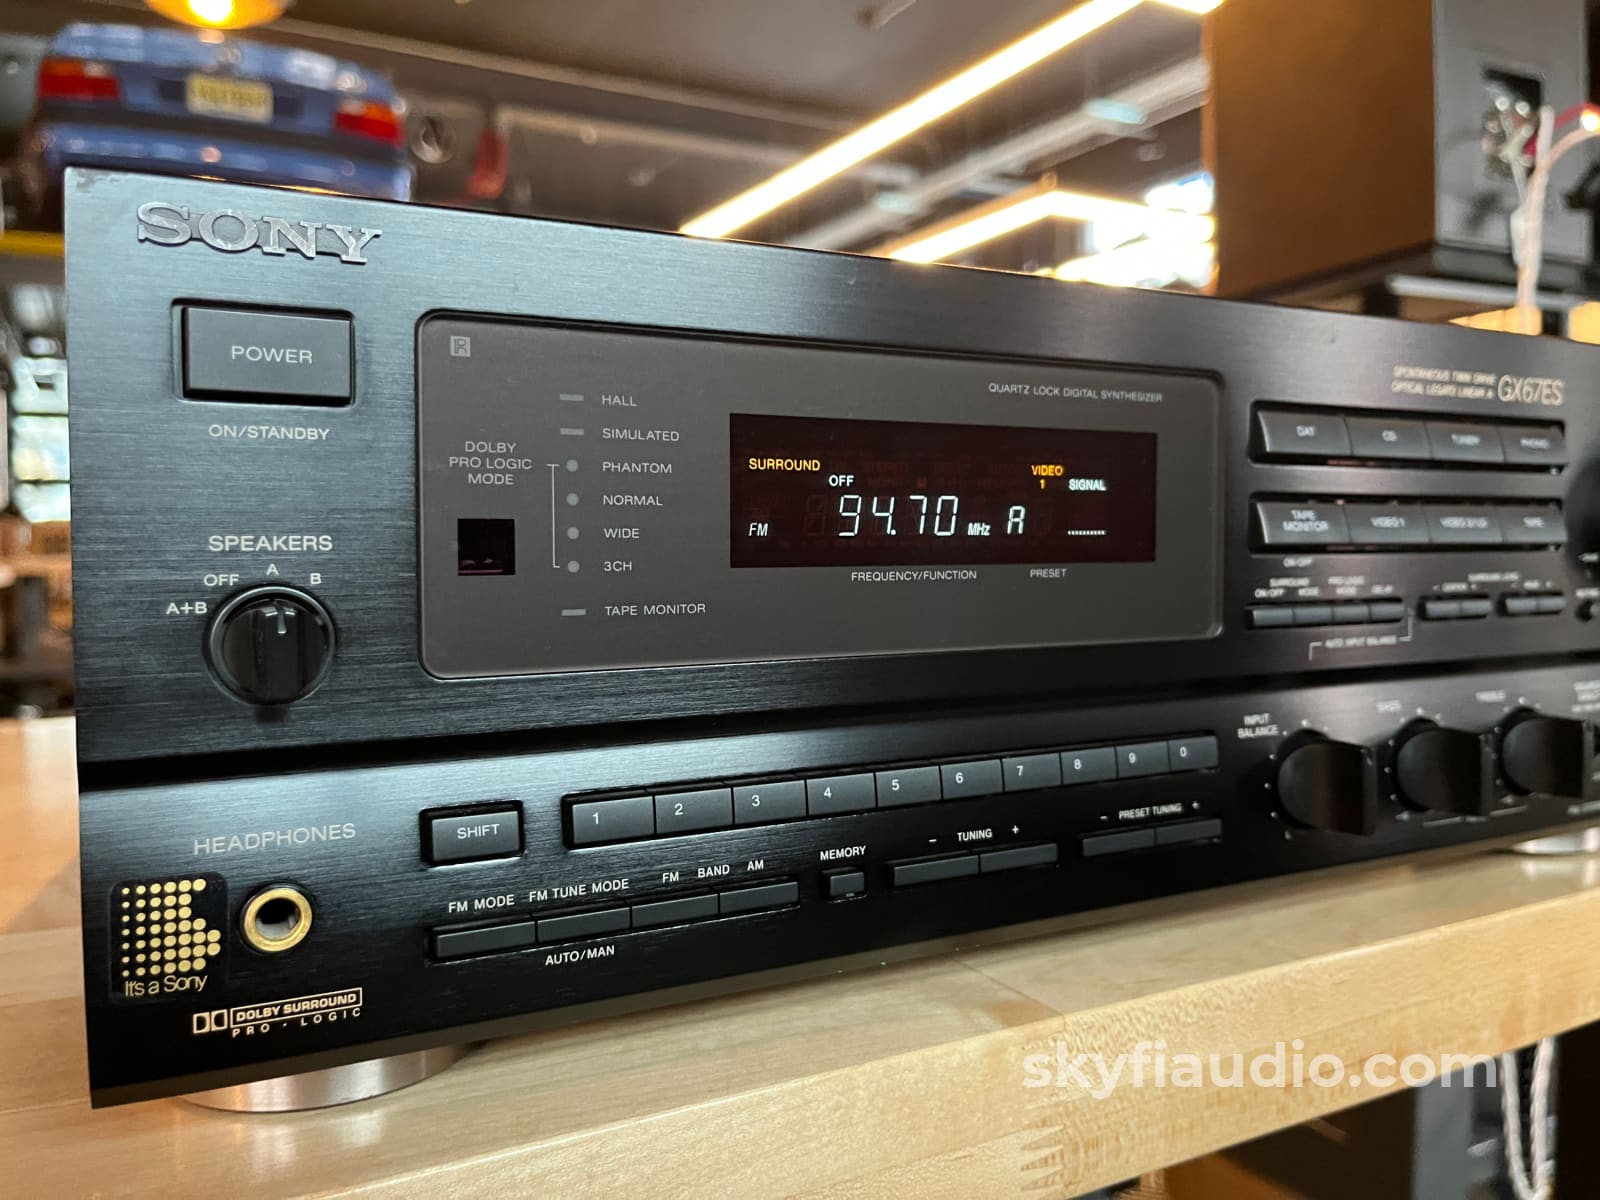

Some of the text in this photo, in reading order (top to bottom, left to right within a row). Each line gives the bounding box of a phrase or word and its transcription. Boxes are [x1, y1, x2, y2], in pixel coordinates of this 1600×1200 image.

[137, 201, 382, 264] SONY
[231, 345, 314, 364] POWER
[988, 383, 1163, 403] QUARTZ LOCK DIGITAL SYNTHESIZER
[1498, 375, 1563, 405] GX67ES
[602, 395, 637, 407] HALL
[208, 424, 330, 440] ON/STANDBY
[602, 428, 680, 442] SIMULATED
[465, 441, 516, 453] DOLBY
[449, 457, 532, 470] PRO LOGIC
[603, 462, 672, 474] PHANTOM
[748, 458, 821, 471] SURROUND
[1031, 464, 1064, 476] VIDEO
[468, 473, 514, 485] MODE
[828, 475, 854, 487] OFF
[1040, 479, 1045, 490] 1
[1068, 479, 1107, 491] SIGNAL
[603, 495, 663, 506] NORMAL
[838, 494, 991, 537] 94.70 MHz
[1007, 506, 1026, 535] A
[604, 528, 640, 539] WIDE
[748, 523, 769, 537] FM
[209, 535, 333, 551] SPEAKERS
[266, 563, 279, 576] A
[604, 561, 632, 572] 3CH
[203, 574, 239, 586] OFF
[310, 573, 321, 585] B
[851, 570, 977, 581] FREQUENCY/FUNCTION
[1030, 569, 1067, 578] PRESET
[166, 601, 207, 615] A+B
[605, 603, 706, 616] TAPE MONITOR
[1244, 713, 1270, 726] INPUT
[1237, 724, 1279, 739] BALANCE
[1129, 752, 1137, 764] 9
[1179, 746, 1188, 758] 0
[1016, 765, 1024, 777] 7
[1074, 759, 1082, 770] 8
[956, 772, 964, 784] 6
[891, 779, 900, 791] 5
[823, 787, 832, 799] 4
[752, 794, 761, 807] 3
[674, 803, 683, 816] 2
[1119, 808, 1150, 820] PRESET
[1152, 803, 1183, 817] TUNING
[592, 812, 600, 825] 1
[457, 824, 500, 840] SHIFT
[957, 828, 993, 843] TUNING
[193, 823, 356, 855] HEADPHONES
[820, 845, 866, 861] MEMORY
[697, 864, 731, 879] BAND
[747, 859, 765, 872] AM
[662, 871, 680, 884] FM
[529, 878, 629, 902] FM TUNE MODE
[448, 894, 515, 913] FM MODE
[545, 945, 615, 966] AUTO/MAN
[148, 981, 160, 995] a
[163, 974, 208, 994] Sony
[236, 993, 358, 1023] DOLBY SURROUND
[232, 1007, 361, 1039] PRO LOGIC
